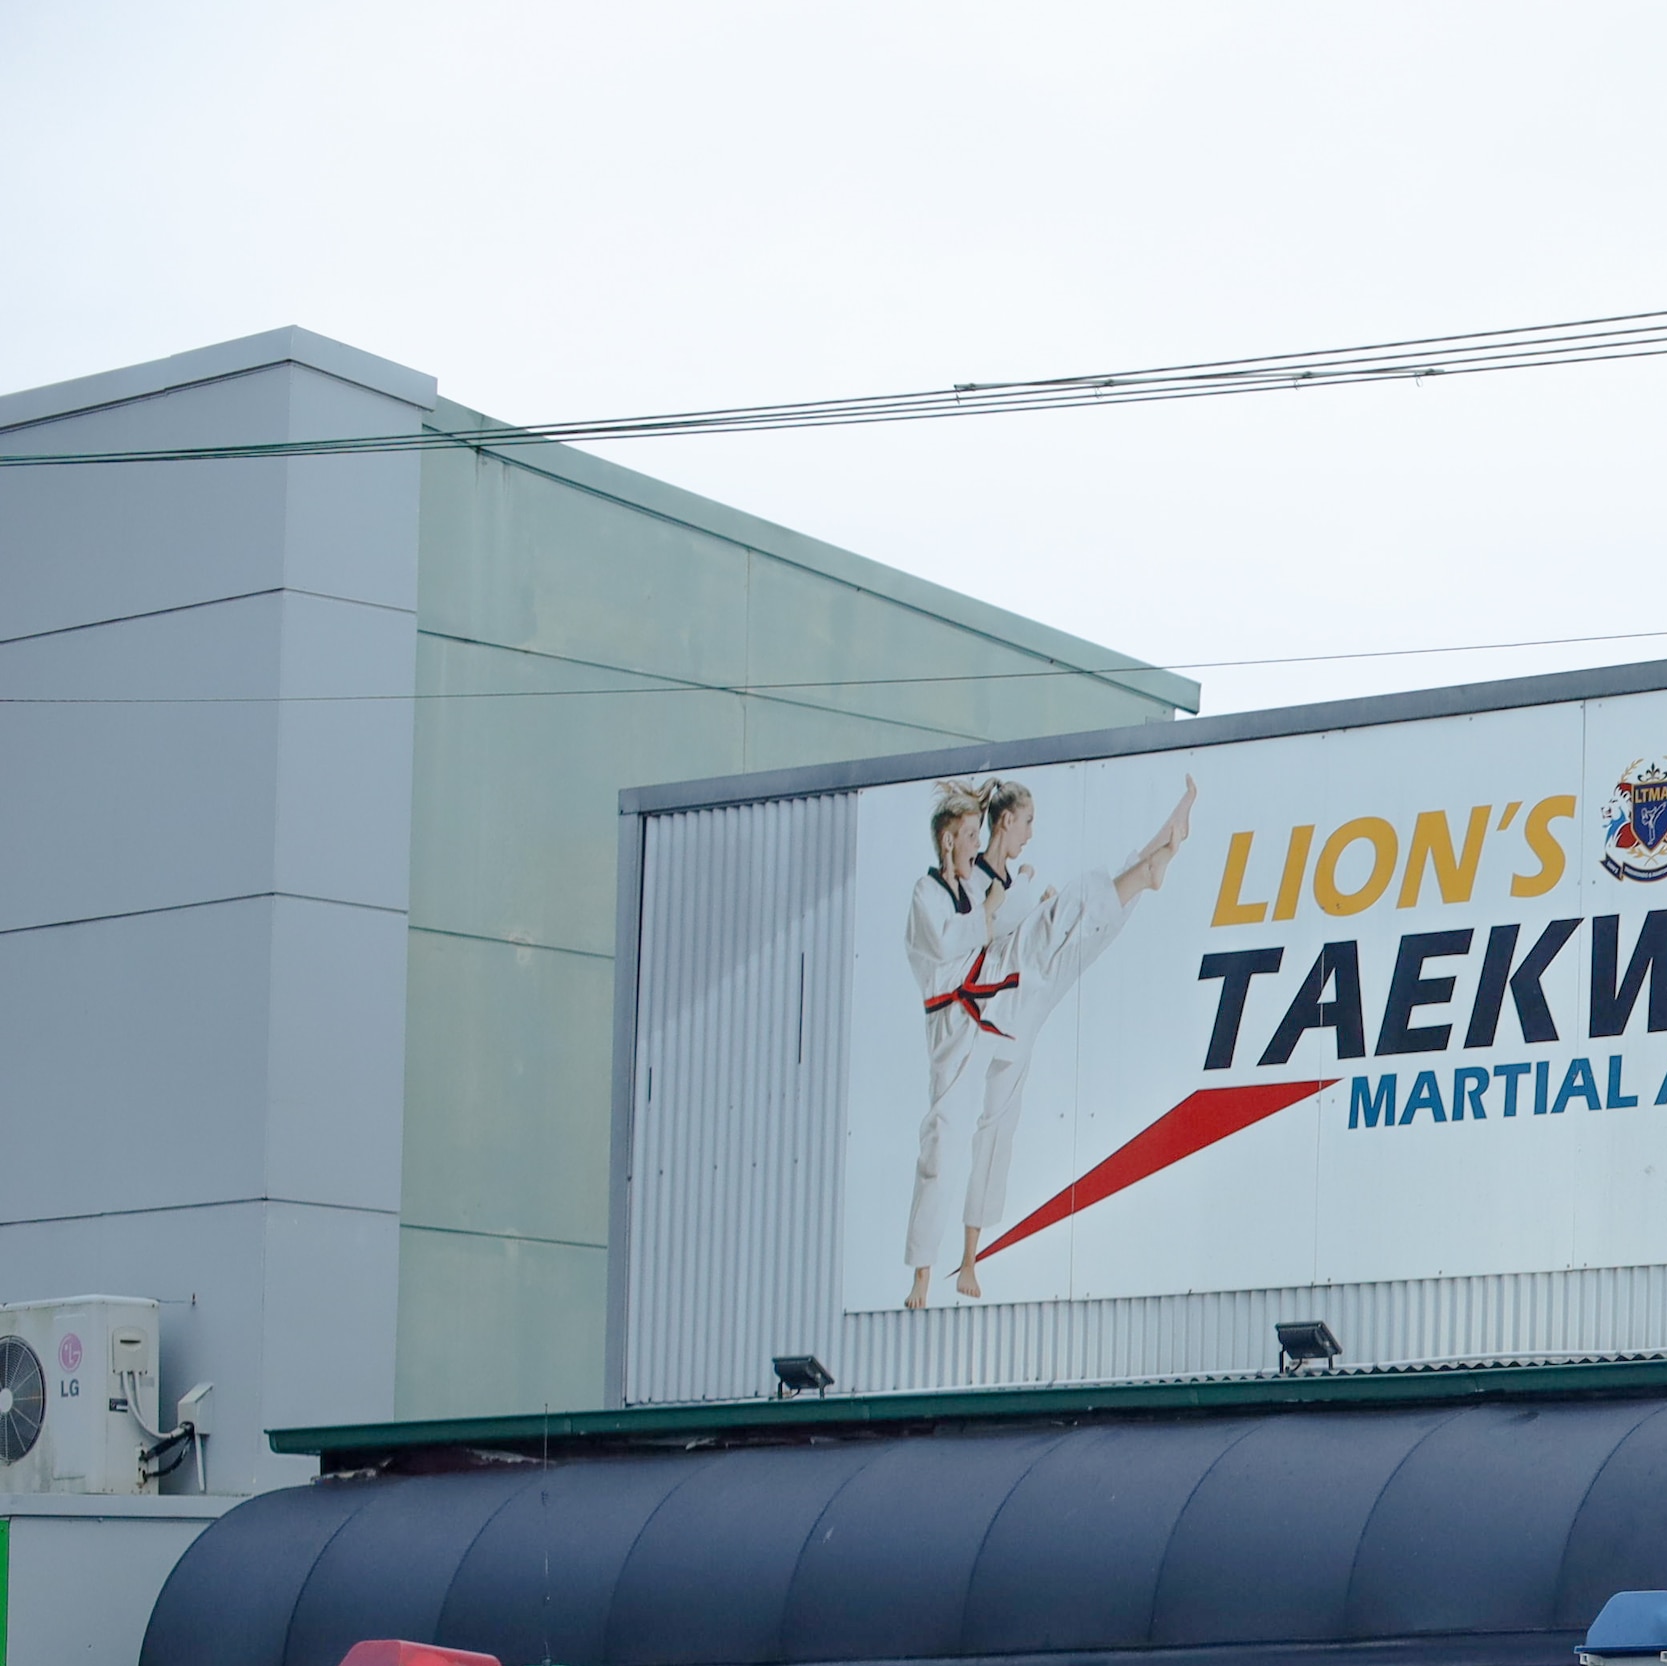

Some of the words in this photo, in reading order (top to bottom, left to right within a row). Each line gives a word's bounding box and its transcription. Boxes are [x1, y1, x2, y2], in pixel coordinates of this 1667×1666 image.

[1210, 794, 1577, 927] LION'S
[1346, 1057, 1638, 1130] MARTIAL
[61, 1380, 79, 1397] LG
